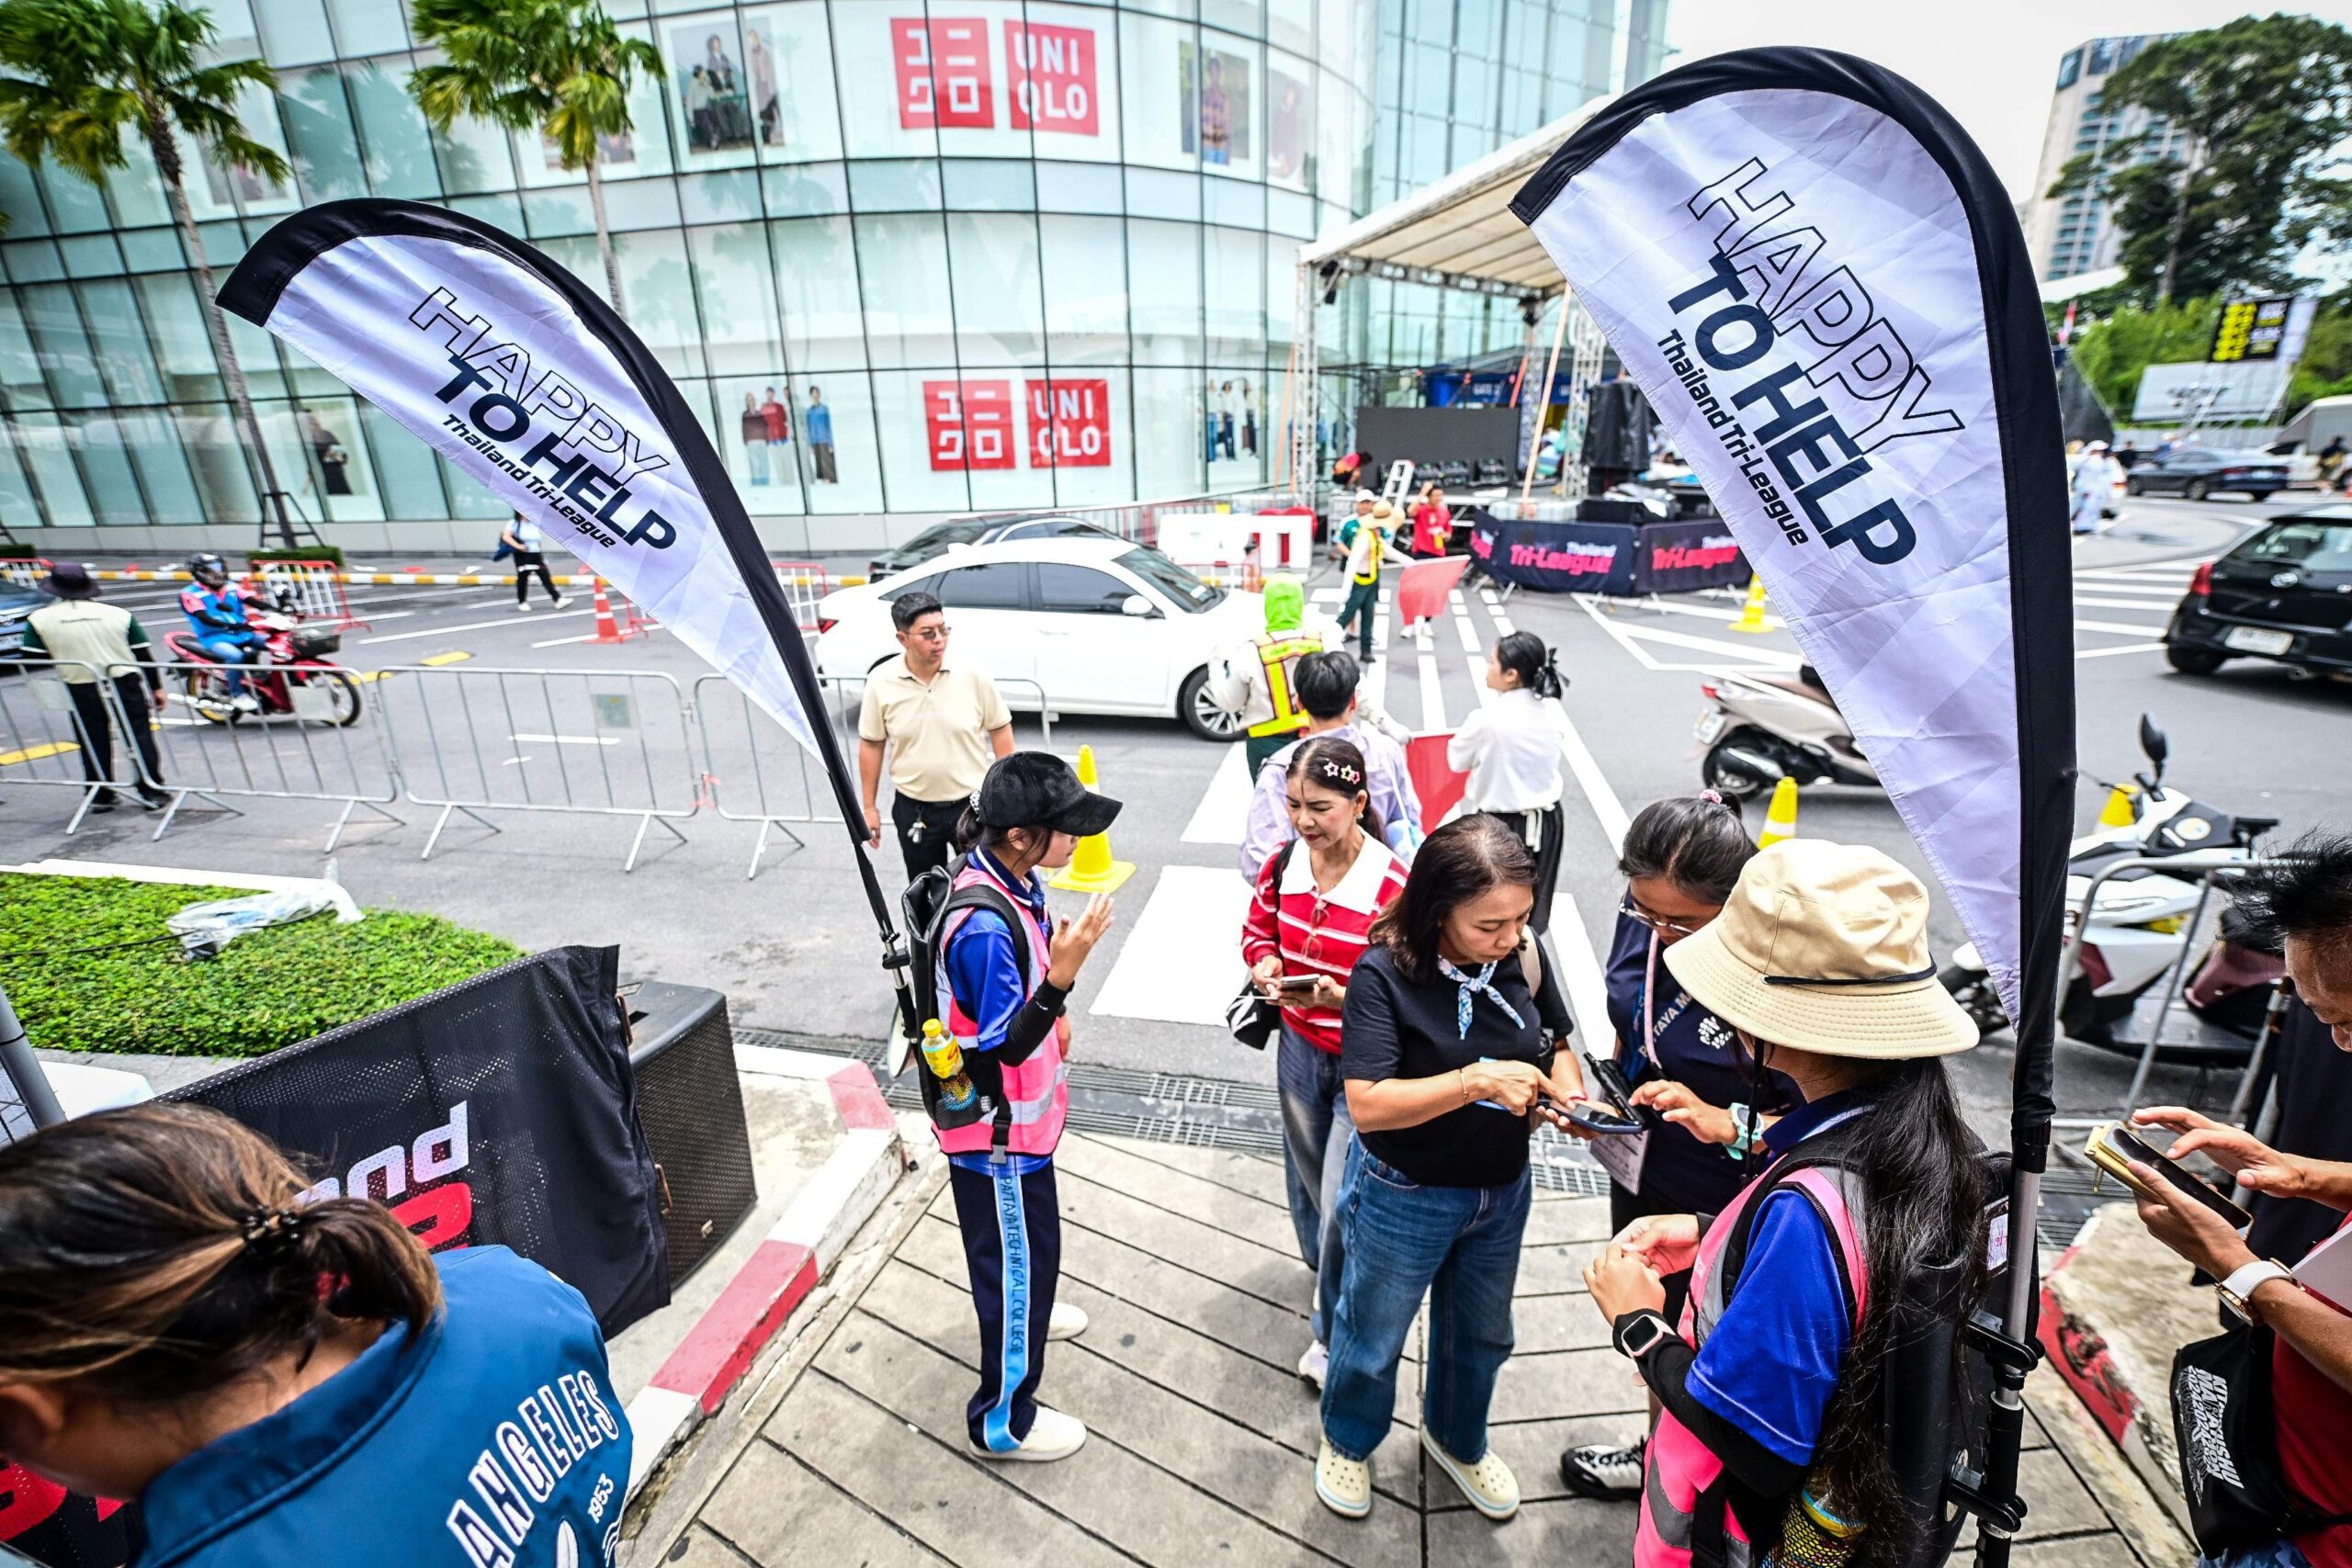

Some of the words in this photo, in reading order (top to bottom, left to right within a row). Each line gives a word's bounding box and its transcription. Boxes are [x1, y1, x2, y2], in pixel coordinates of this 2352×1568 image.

[1013, 32, 1080, 76] UNI
[1017, 81, 1088, 124] QLO
[1687, 156, 1965, 456] HAPPY
[409, 286, 671, 487] HAPPY
[1035, 389, 1094, 420] UNI
[1668, 251, 1775, 371] TO
[1729, 361, 1917, 566] HELP
[435, 354, 531, 443] TO
[520, 431, 677, 550] HELP
[1036, 426, 1102, 463] QLO
[1657, 329, 1734, 434] Thailand
[1719, 418, 1809, 547] Tri-League
[442, 413, 531, 482] Thailand
[524, 475, 616, 548] Tri-League
[1510, 544, 1613, 576] Tri-League
[1638, 1007, 1679, 1058] PTAYA
[999, 1176, 1018, 1224] PATTAYA
[1007, 1224, 1025, 1296] TECHNICAL
[1008, 1299, 1025, 1354] COLLEGE
[446, 1370, 619, 1568] ANGELES
[587, 1472, 615, 1524] 1953
